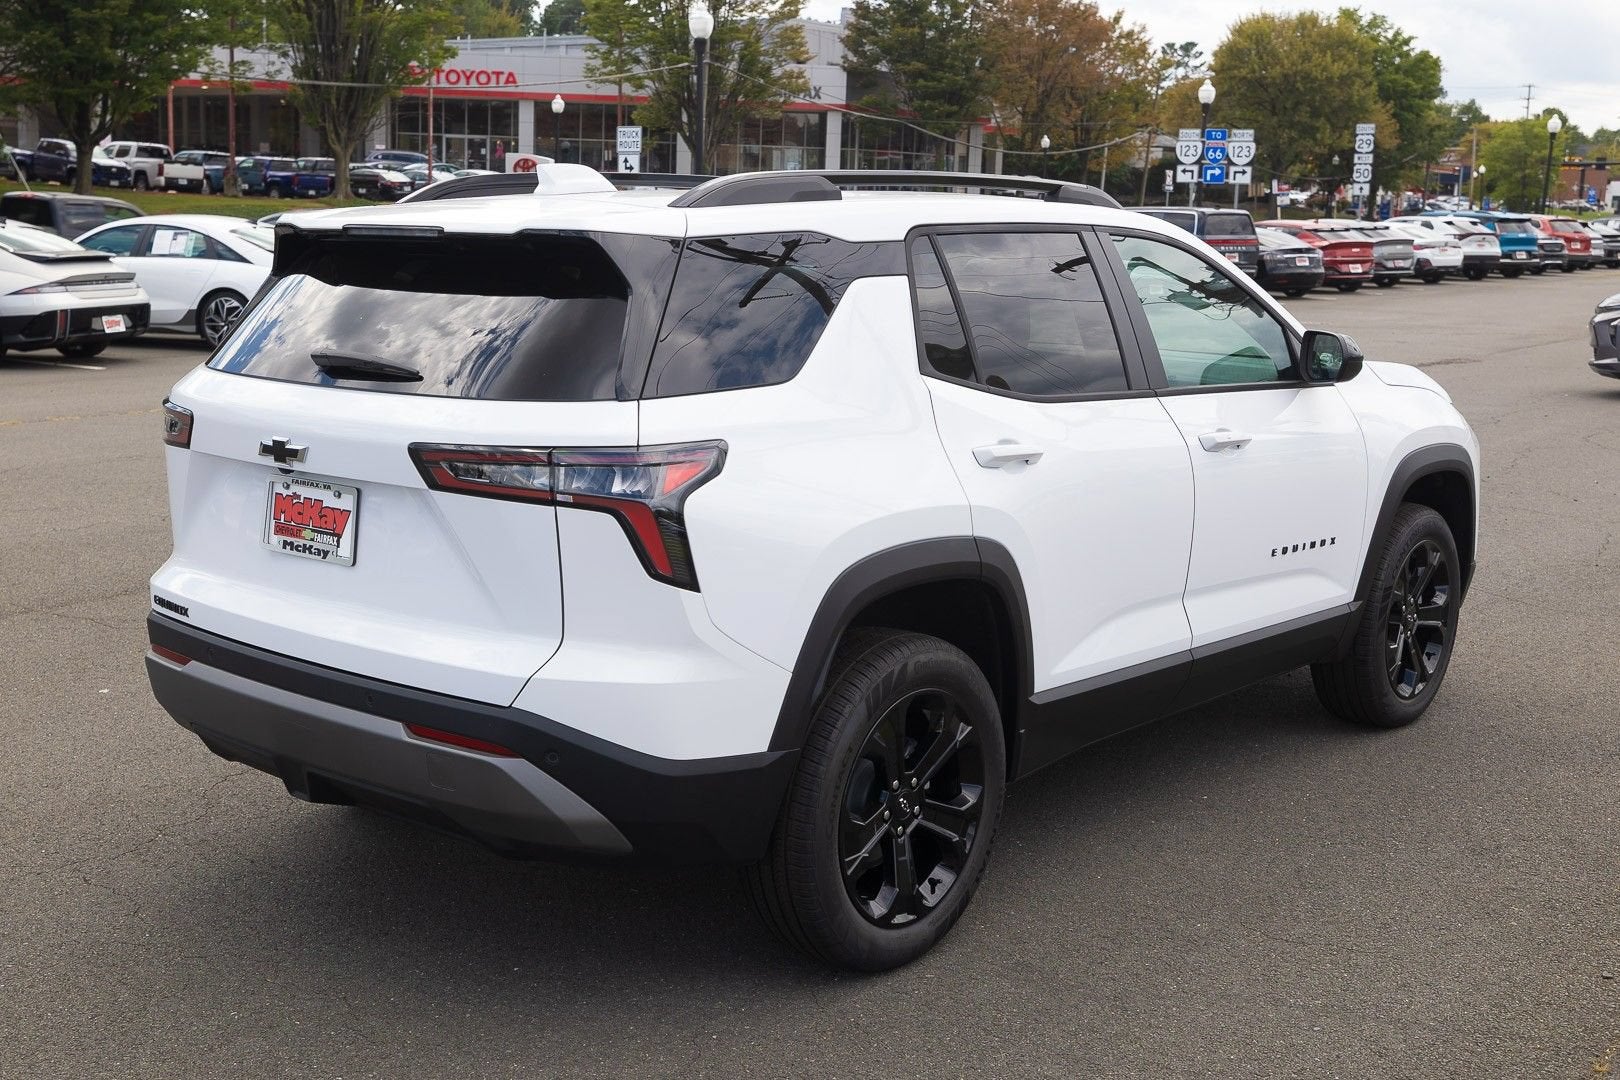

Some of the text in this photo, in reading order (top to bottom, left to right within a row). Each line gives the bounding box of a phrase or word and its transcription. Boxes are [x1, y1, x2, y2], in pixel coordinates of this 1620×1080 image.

[432, 67, 518, 86] TOYOTA
[619, 130, 639, 139] TRUCK
[619, 141, 639, 149] ROUTE
[1357, 139, 1372, 149] 29
[1179, 145, 1199, 157] 123
[1208, 149, 1223, 159] 66
[1232, 146, 1251, 158] 123
[1355, 168, 1370, 179] 50
[273, 492, 351, 535] McKay
[314, 533, 338, 546] FAIRFAX
[282, 540, 330, 560] McKay
[1271, 536, 1337, 557] EQUINOX
